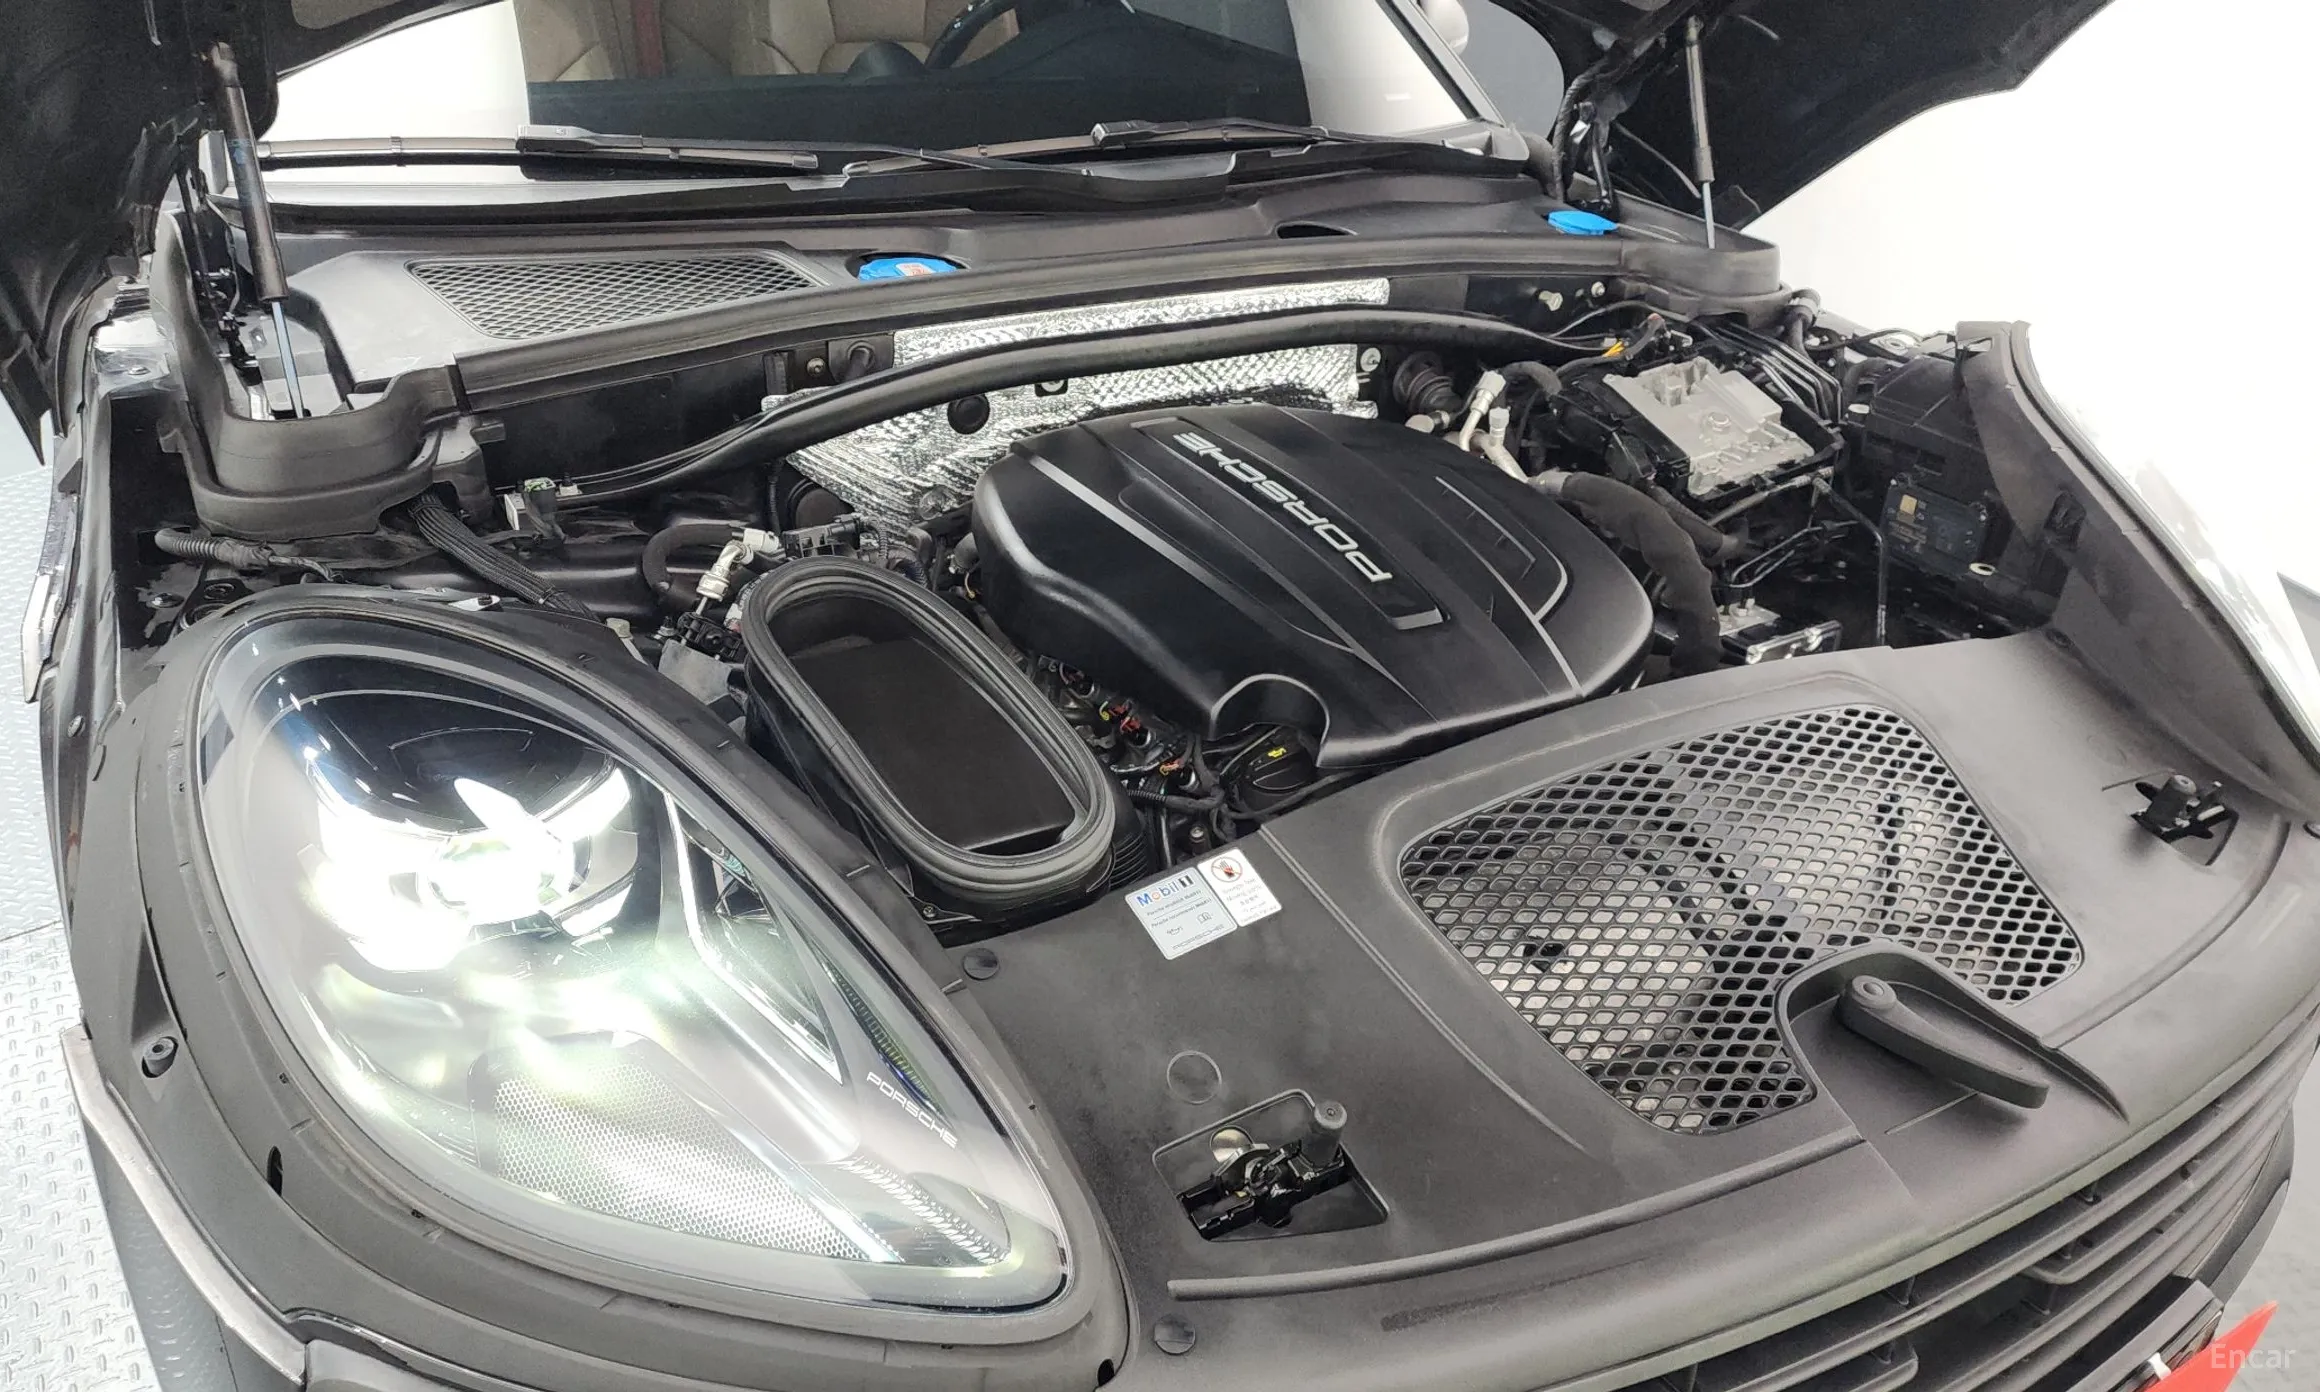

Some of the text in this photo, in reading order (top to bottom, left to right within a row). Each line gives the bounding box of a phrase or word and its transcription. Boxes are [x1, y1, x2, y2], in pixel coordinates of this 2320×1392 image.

[1172, 431, 1393, 583] PORSCHE
[1136, 881, 1180, 907] Mobil
[866, 1071, 958, 1149] PORSCHE
